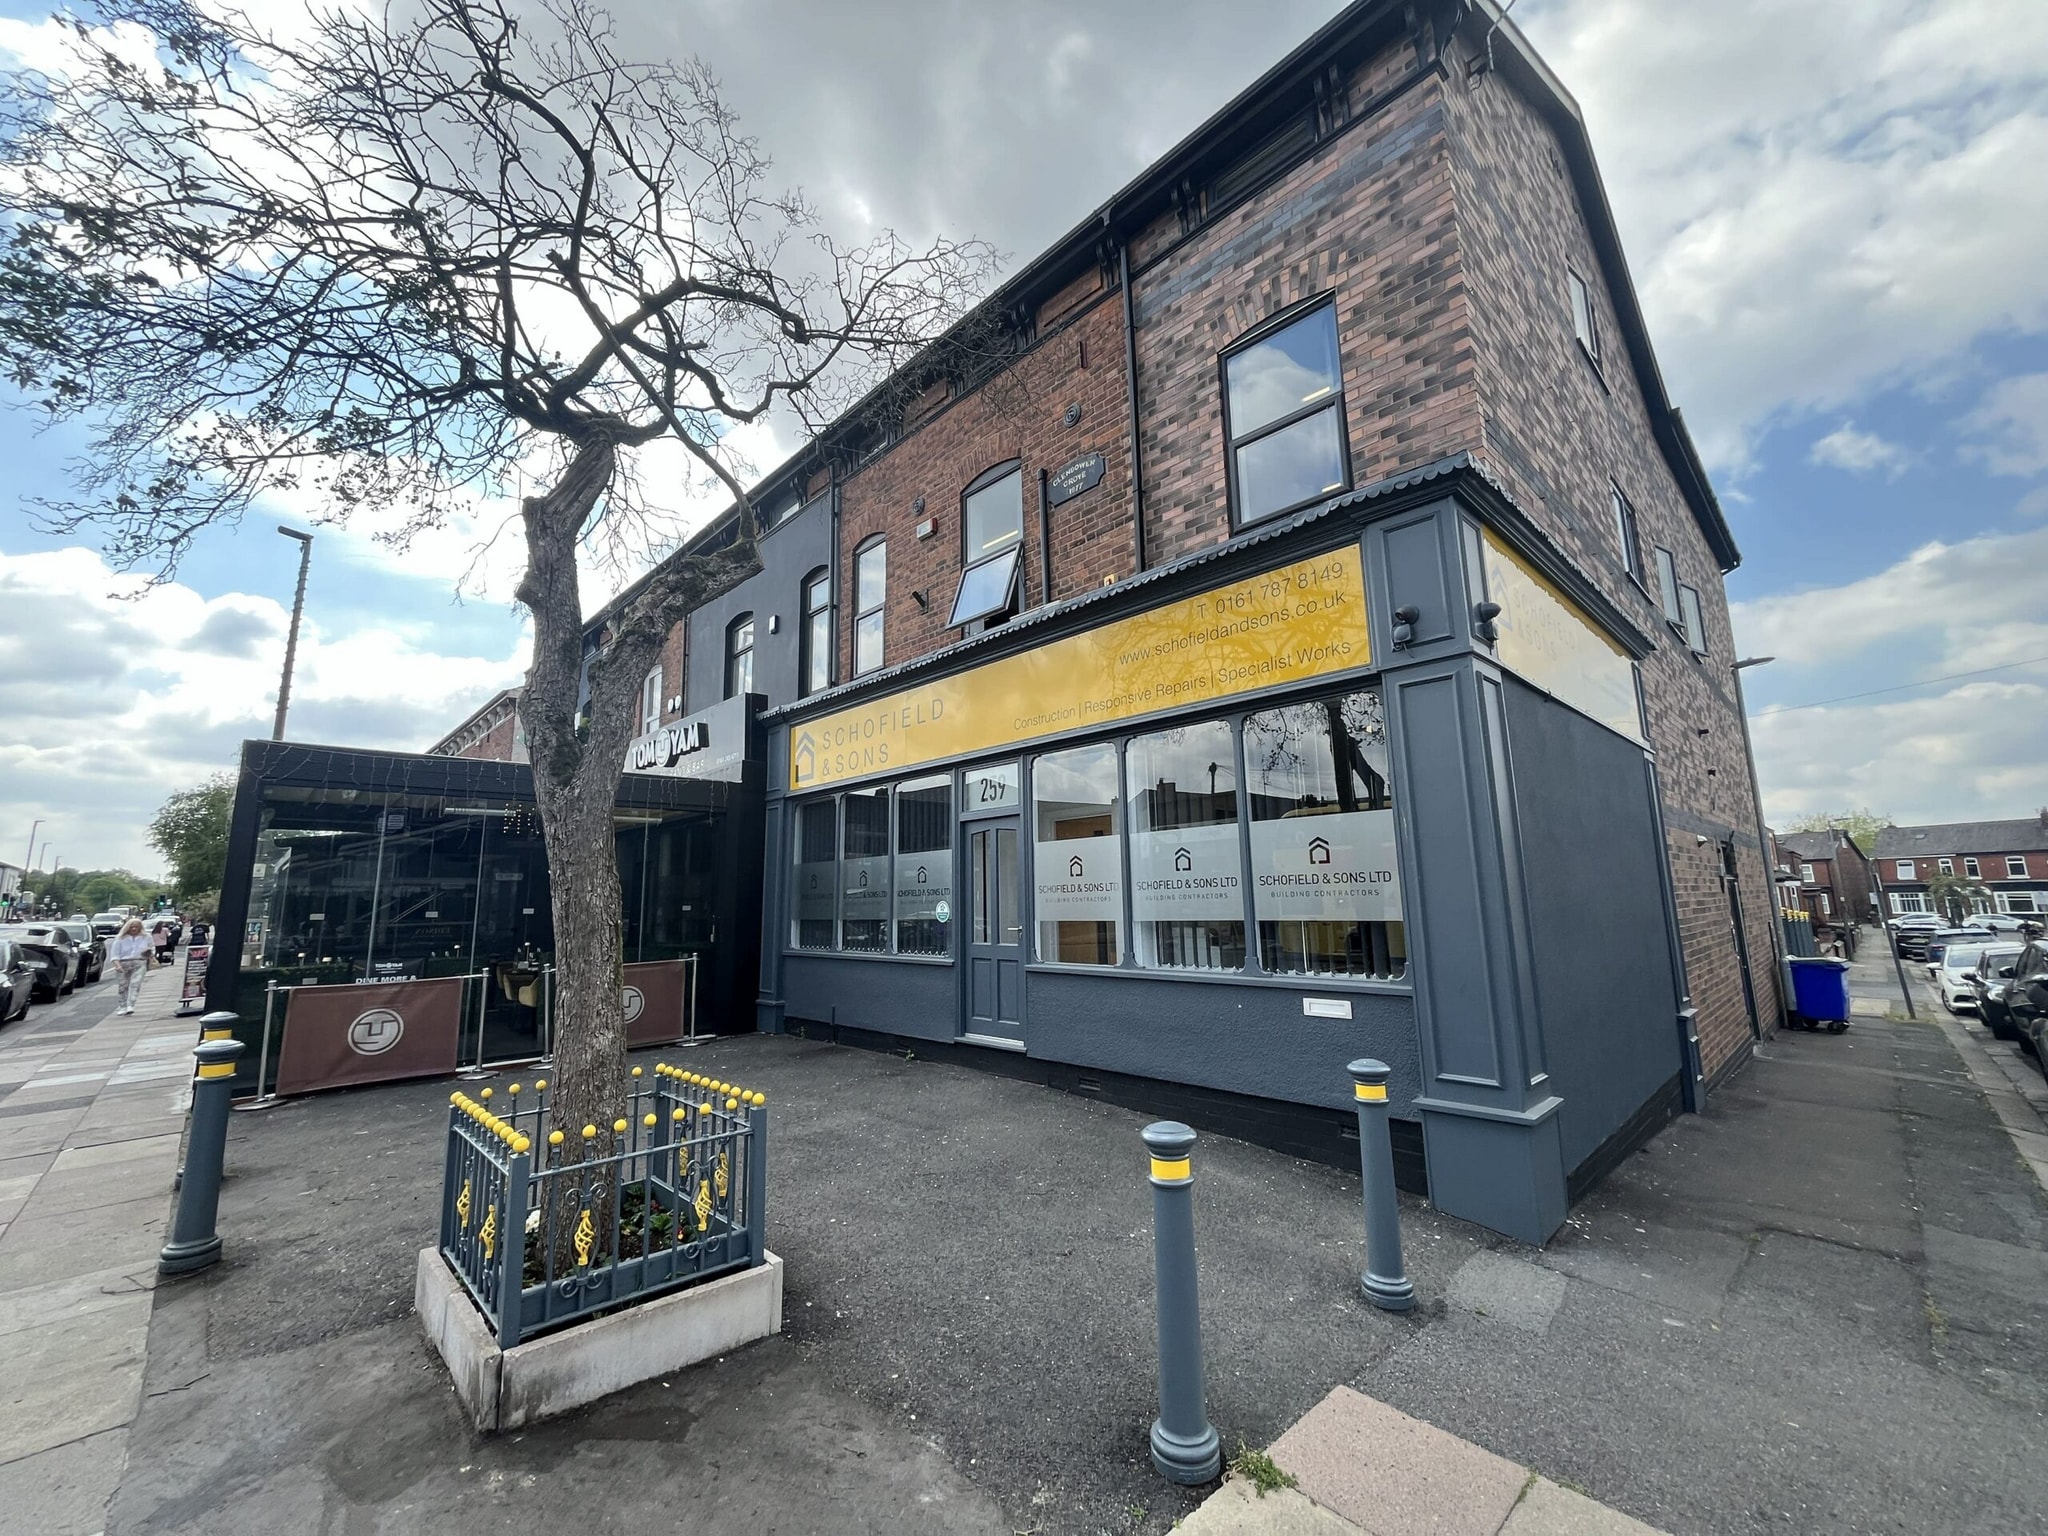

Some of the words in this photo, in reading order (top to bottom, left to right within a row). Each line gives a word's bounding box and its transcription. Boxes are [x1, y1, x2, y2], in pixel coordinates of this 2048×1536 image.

[1197, 604, 1206, 619] T
[1215, 591, 1253, 614] 0161
[1260, 577, 1291, 600] 787
[1297, 562, 1343, 589] 8149
[1119, 589, 1347, 665] www.schofieldandsons.co.uk
[1013, 707, 1076, 731] Construction
[1084, 688, 1152, 714] Responsive
[1156, 675, 1206, 698] Repairs
[1218, 654, 1292, 684] Specialist
[1297, 641, 1351, 664] Works
[822, 698, 944, 750] SCHOFIELD
[631, 740, 656, 769] TOM
[670, 722, 699, 755] YAM
[981, 775, 1005, 802] 259
[1038, 884, 1076, 894] SCHOFIELD
[1077, 883, 1083, 892] &
[1084, 882, 1104, 892] SONS
[1105, 882, 1119, 892] LTD
[1136, 880, 1183, 891] SCHOFIELD
[1185, 879, 1191, 888] &
[1193, 877, 1219, 888] SONS
[1220, 877, 1238, 888] LTD
[1259, 873, 1320, 886] SCHOFIELD
[1322, 873, 1331, 884] &
[1333, 871, 1367, 884] SONS
[1369, 870, 1392, 883] LTD
[1270, 890, 1310, 898] BUILDING
[1314, 889, 1380, 897] CONTRACTORS
